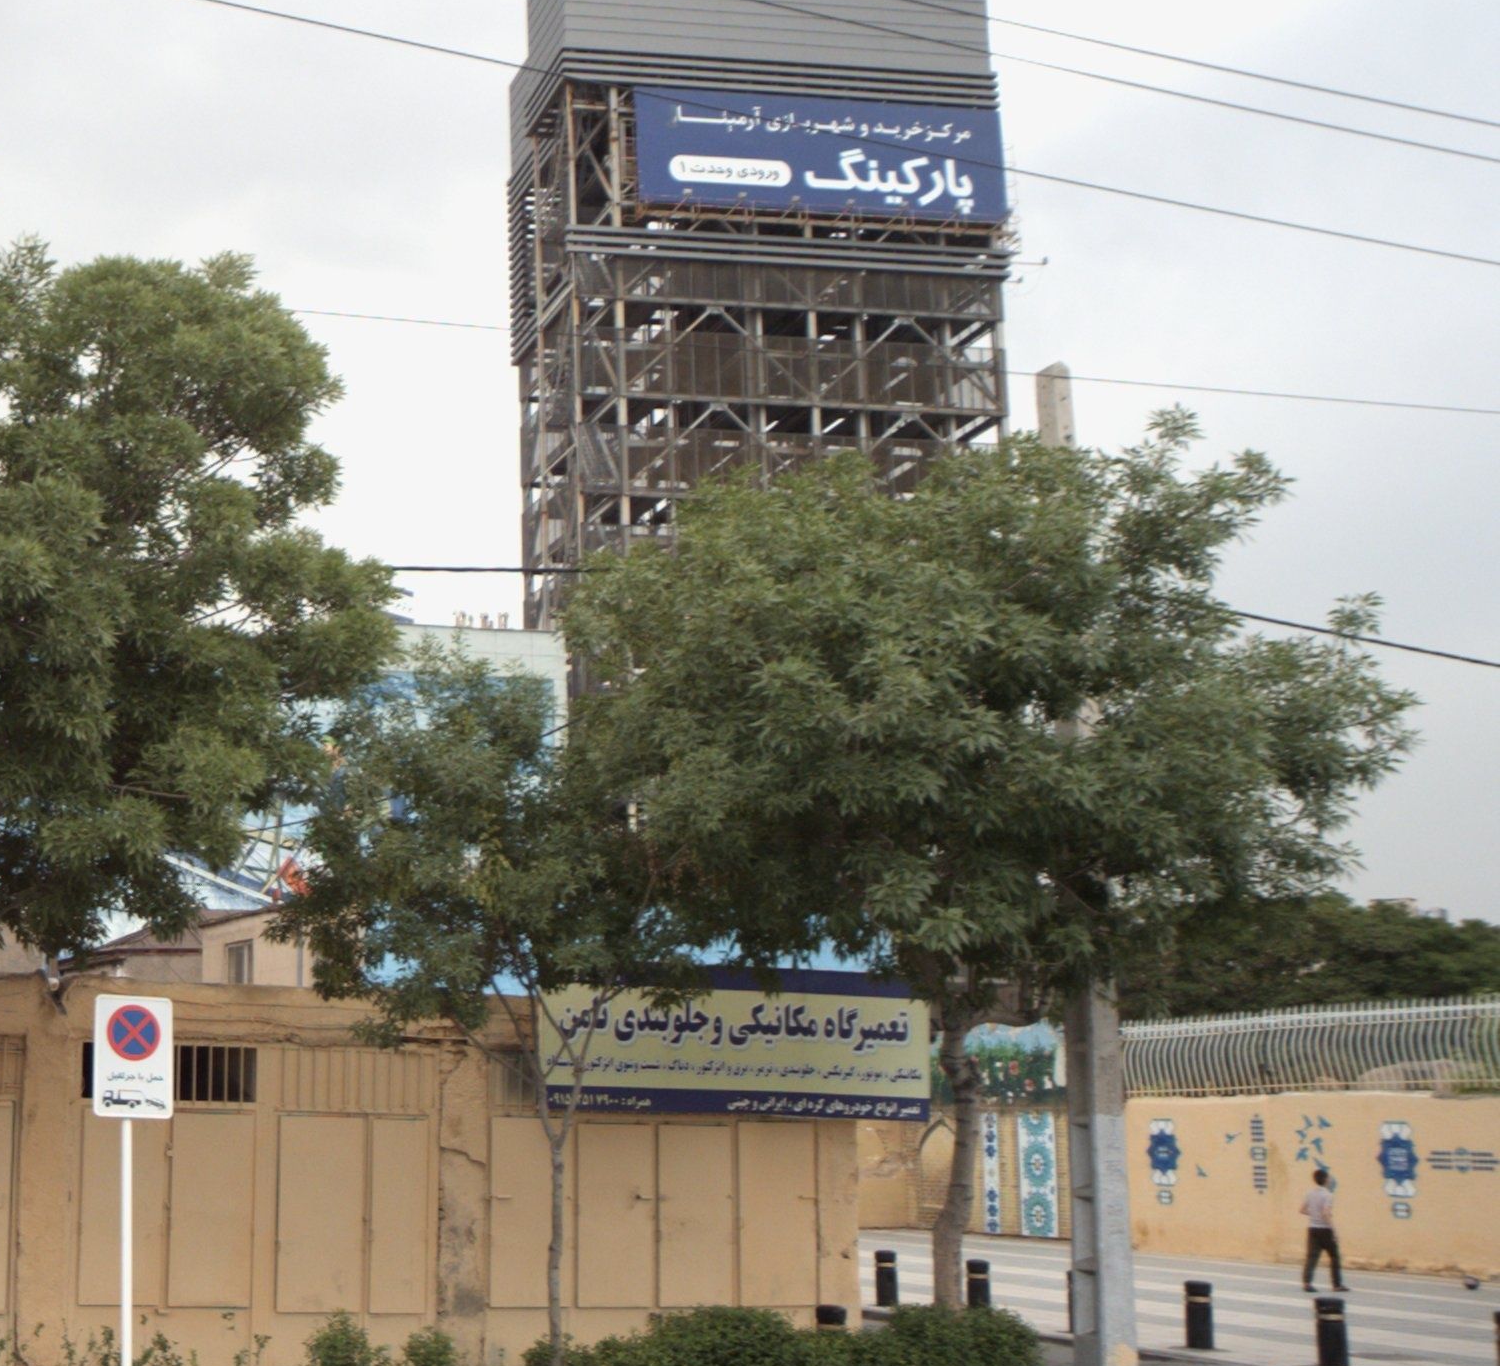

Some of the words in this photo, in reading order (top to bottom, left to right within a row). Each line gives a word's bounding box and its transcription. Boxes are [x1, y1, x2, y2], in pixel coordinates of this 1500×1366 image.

[860, 123, 869, 137] و
[873, 121, 924, 141] خرید
[924, 123, 972, 144] مرکز
[690, 164, 733, 178] وحدت
[737, 167, 781, 181] ورودی
[804, 148, 975, 215] پارکینگ
[729, 1003, 818, 1046] مکانیکی
[823, 1007, 910, 1051] تعمیرگاه
[146, 1073, 164, 1083] حمل
[753, 1101, 759, 1111] و
[825, 1099, 873, 1115] خودروهای
